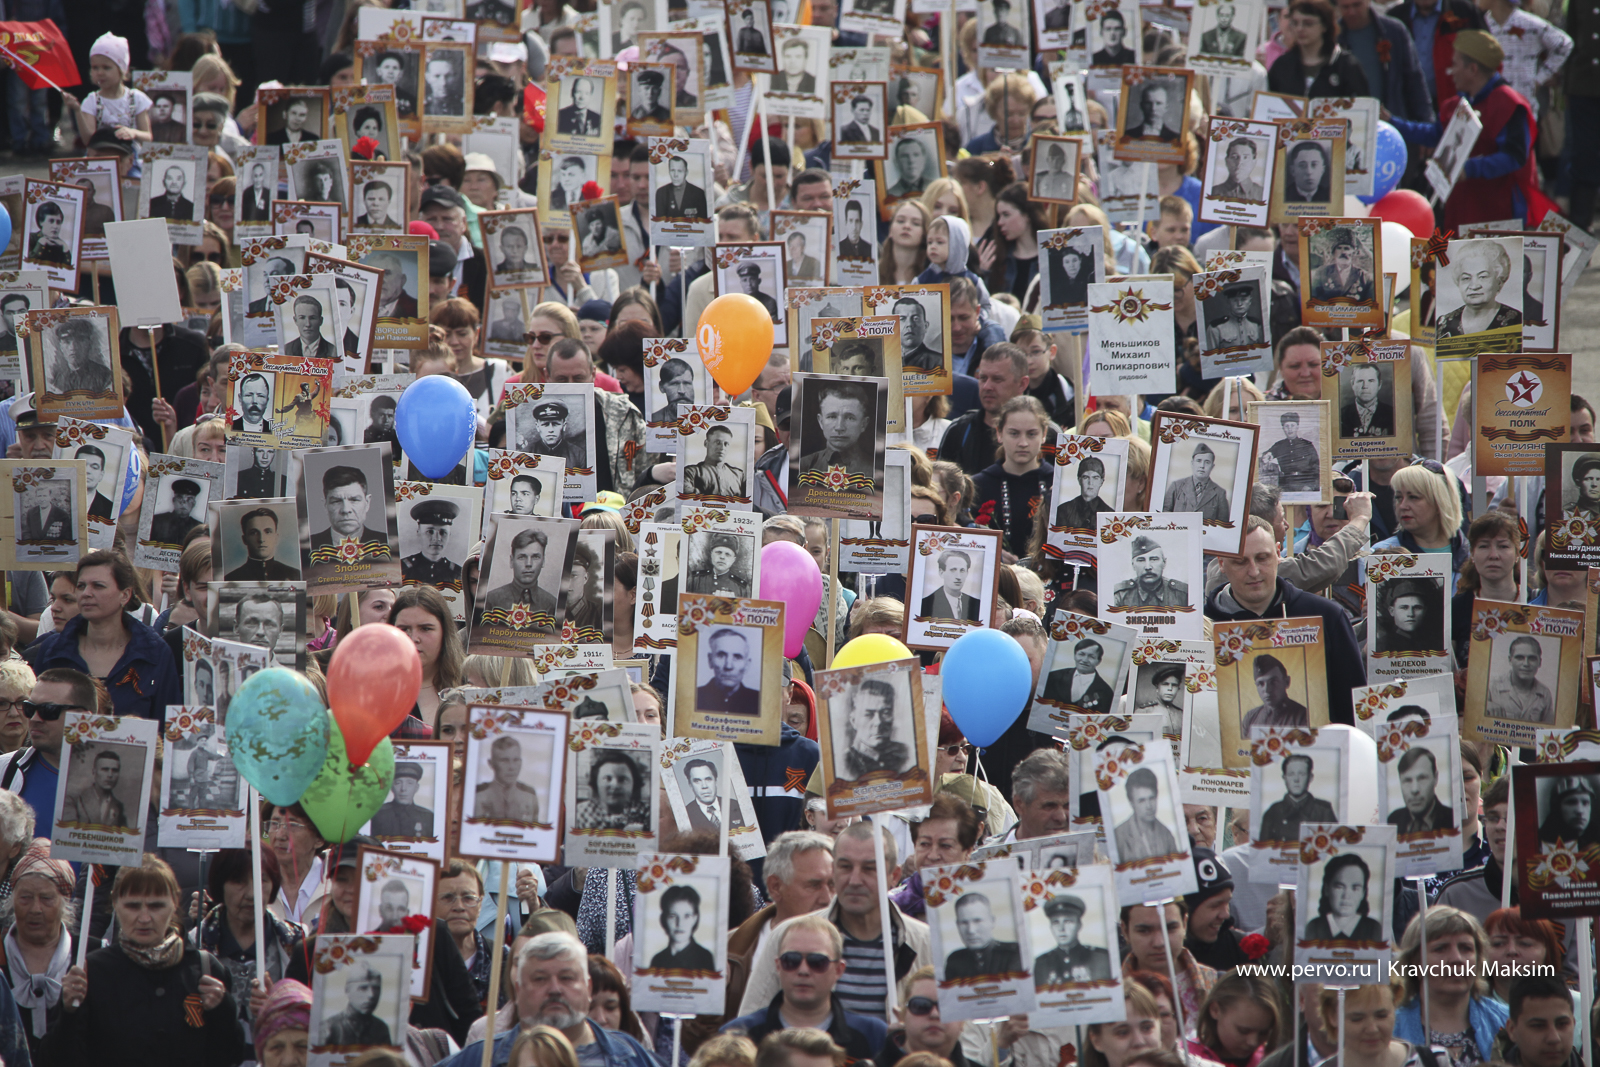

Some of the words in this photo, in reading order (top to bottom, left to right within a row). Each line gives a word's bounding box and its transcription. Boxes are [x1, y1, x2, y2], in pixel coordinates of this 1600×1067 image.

[1381, 161, 1397, 183] 9
[868, 326, 894, 335] ПОЛК
[699, 323, 716, 357] 9
[1101, 340, 1161, 349] Меньшиков
[1111, 351, 1151, 360] Михаил
[1379, 352, 1405, 360] ПОЛК
[1095, 362, 1170, 372] Поликарпович
[1509, 419, 1536, 428] ПОЛК
[1350, 440, 1386, 448] Сидоренко
[807, 489, 867, 500] Дресвянников
[804, 496, 829, 505] Сергей
[830, 498, 873, 508] Михайлович
[733, 517, 755, 526] 1923г.
[334, 562, 372, 574] Злобин
[317, 576, 343, 584] Степан
[344, 572, 389, 583] Васильевич
[746, 614, 777, 625] ПОЛК
[1126, 615, 1177, 626] ЗИЯЗДИНОВ
[489, 628, 546, 640] Нарбутовских
[1142, 625, 1159, 634] Аюп
[1544, 623, 1578, 636] ПОЛК
[482, 637, 516, 647] Владимир
[1286, 634, 1318, 644] ПОЛК
[583, 651, 605, 659] 1911г.
[1390, 660, 1427, 668] МЕЛЕХОВ
[1375, 668, 1400, 676] Федор
[1400, 667, 1443, 675] Семенович
[1476, 725, 1509, 736] Михаил
[1200, 778, 1245, 789] ПОНОМАРЕВ
[1192, 784, 1217, 794] Виктор
[68, 831, 125, 845] ГРЕБЕНЩИКОВ
[54, 839, 81, 849] Степан
[81, 842, 139, 854] Александрович
[588, 840, 637, 850] БОГАТЫРЕВА
[1563, 881, 1598, 890] Иванов
[1542, 890, 1571, 900] Павел
